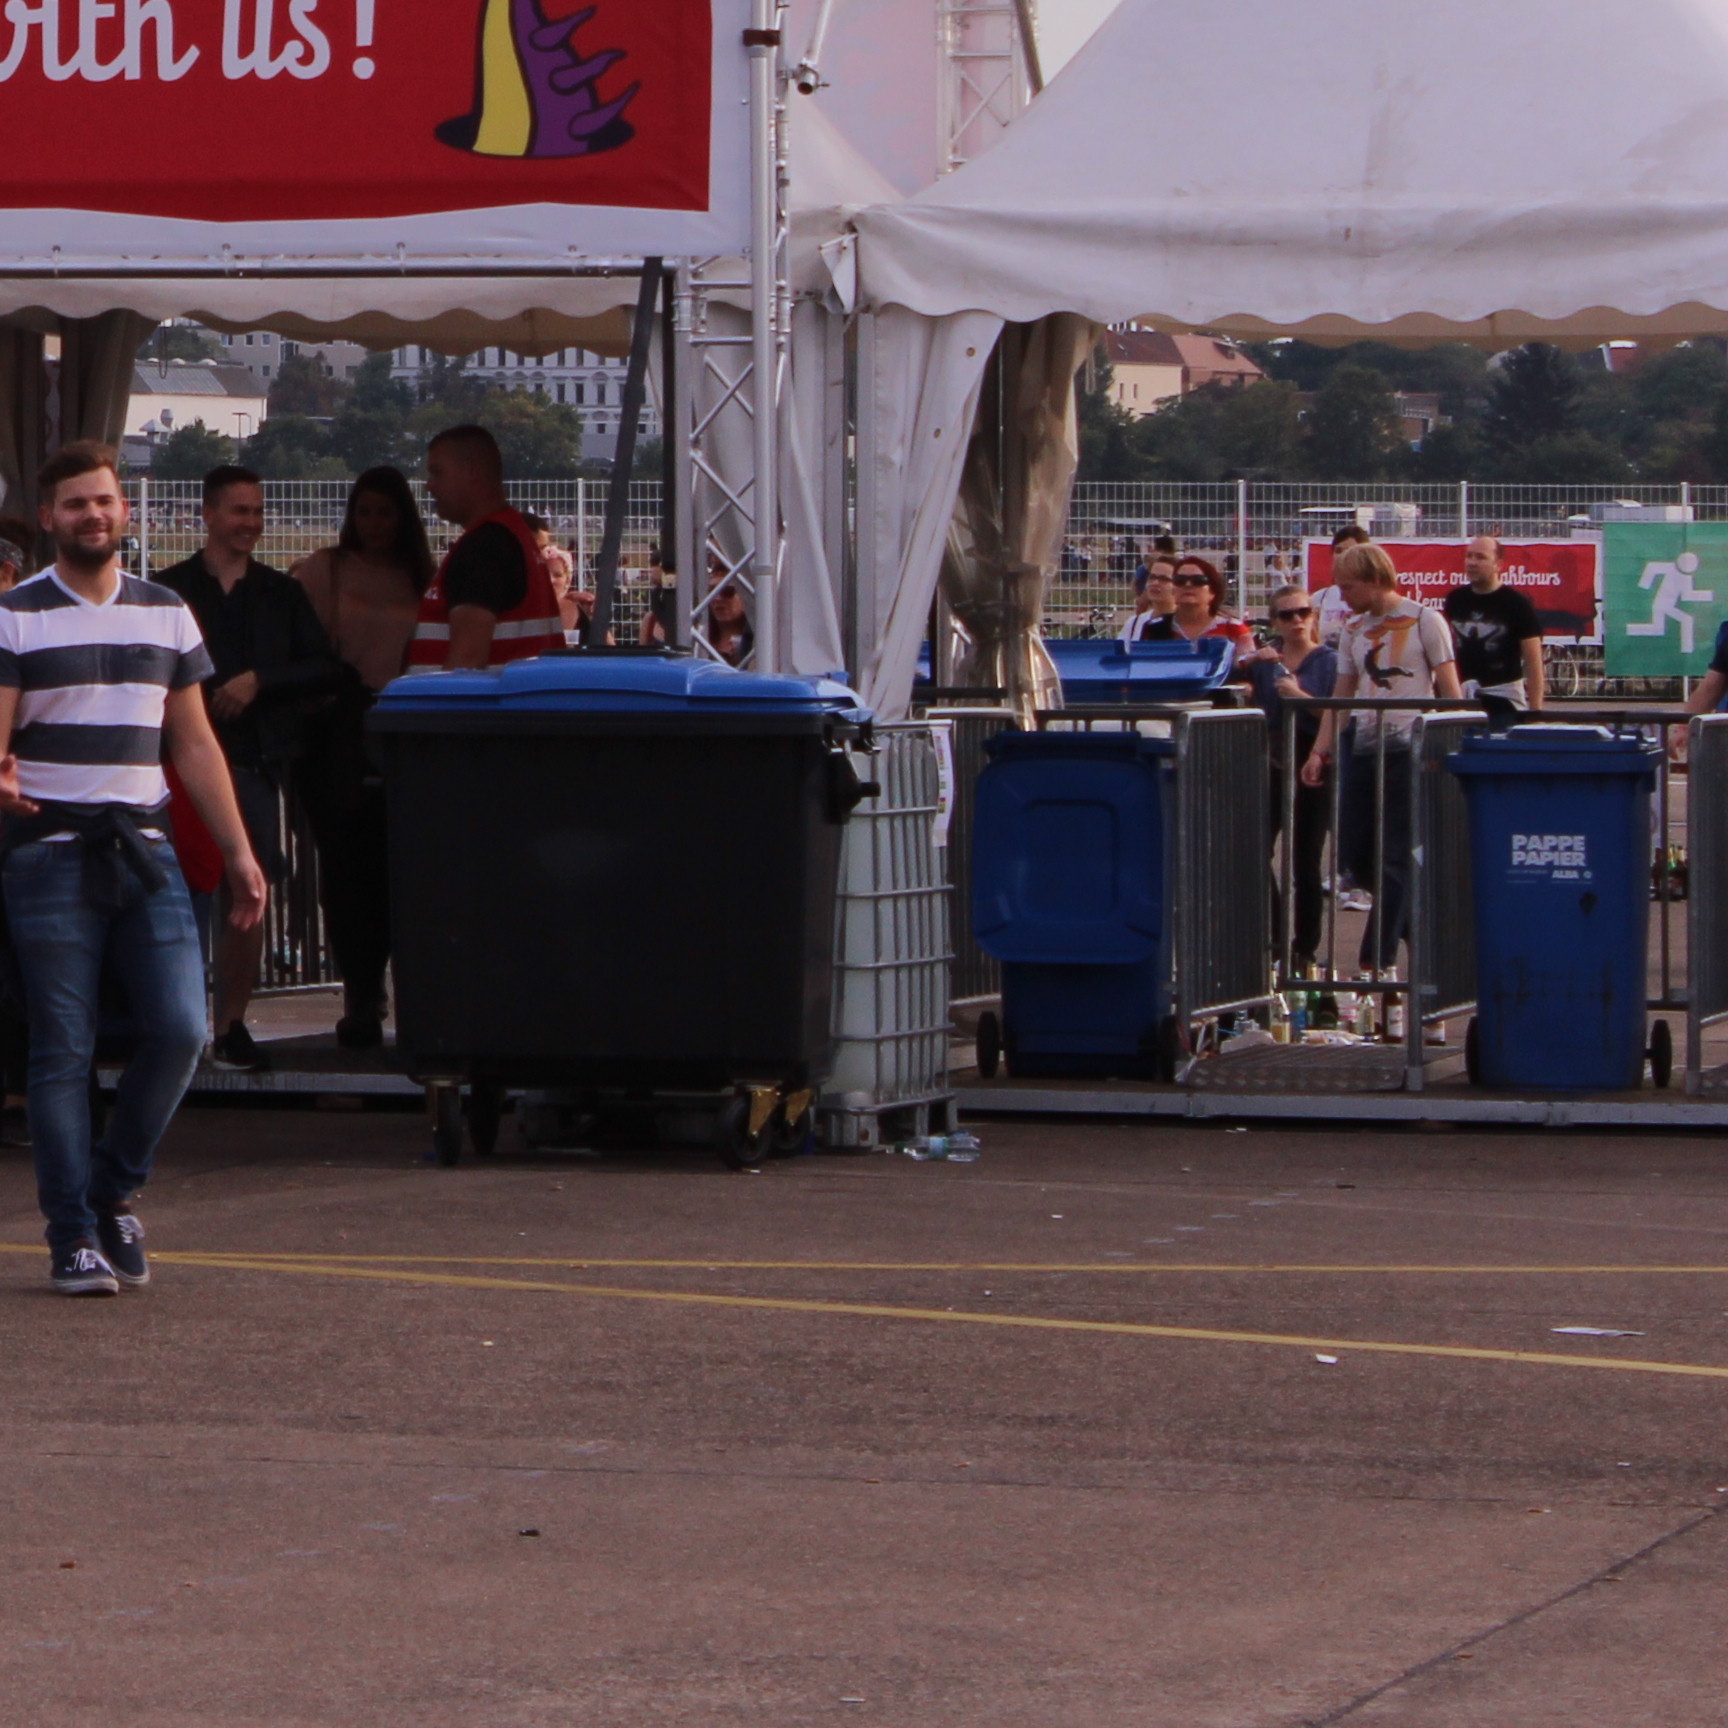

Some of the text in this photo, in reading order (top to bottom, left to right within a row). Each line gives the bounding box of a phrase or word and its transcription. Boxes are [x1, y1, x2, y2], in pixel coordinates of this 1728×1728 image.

[1396, 569, 1448, 591] respect
[1512, 835, 1586, 851] PAPPE
[1512, 851, 1587, 867] PAPIER
